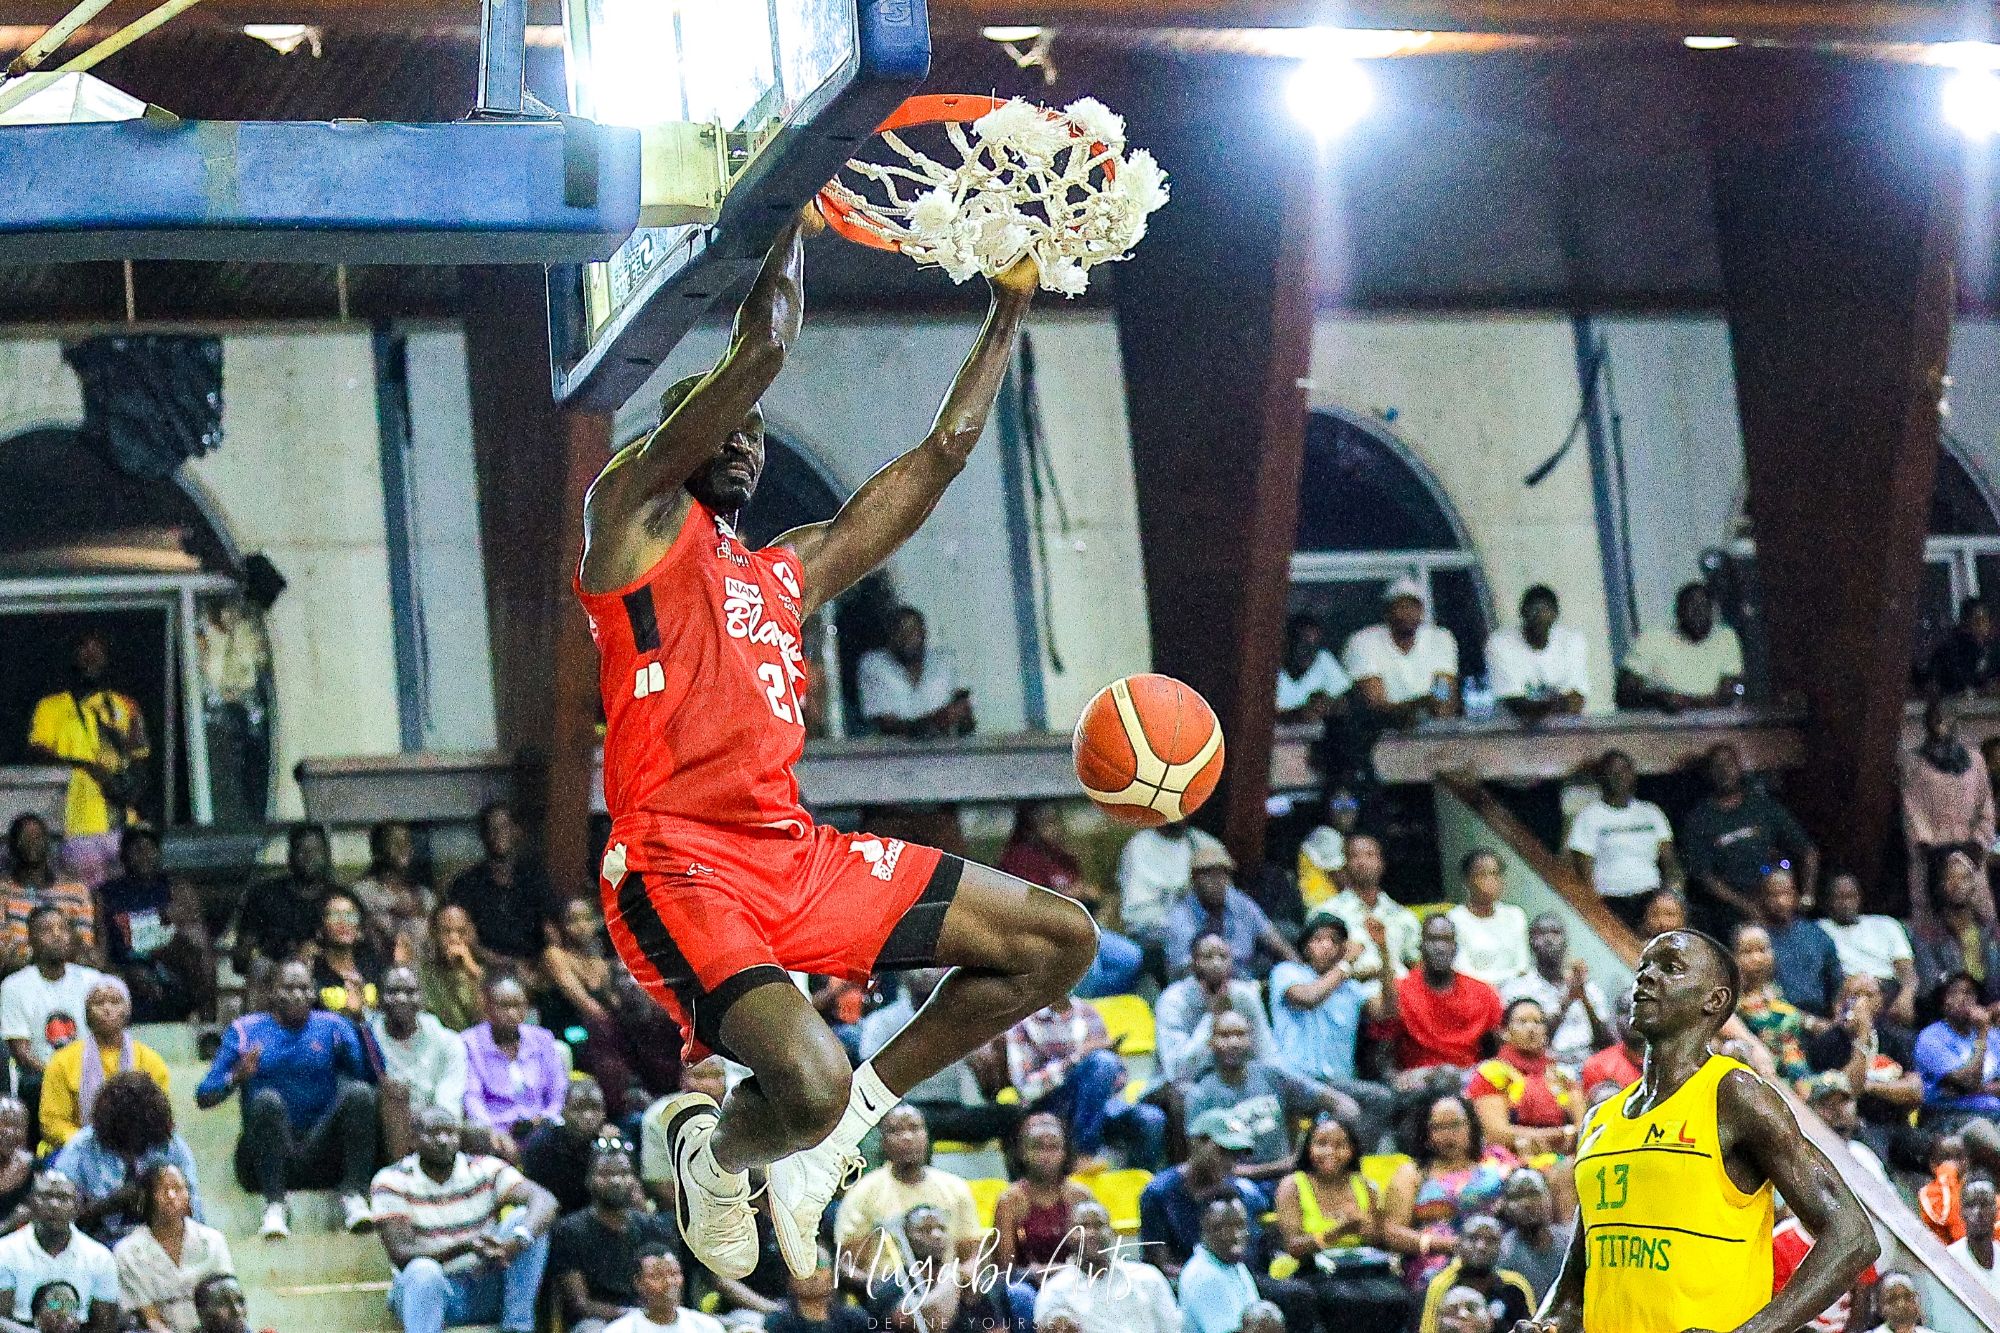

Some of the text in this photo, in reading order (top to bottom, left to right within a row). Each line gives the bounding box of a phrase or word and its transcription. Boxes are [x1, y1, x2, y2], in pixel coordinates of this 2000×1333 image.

[1643, 1119, 1696, 1144] NL
[1596, 1163, 1629, 1210] 13
[1595, 1234, 1672, 1271] TITANS
